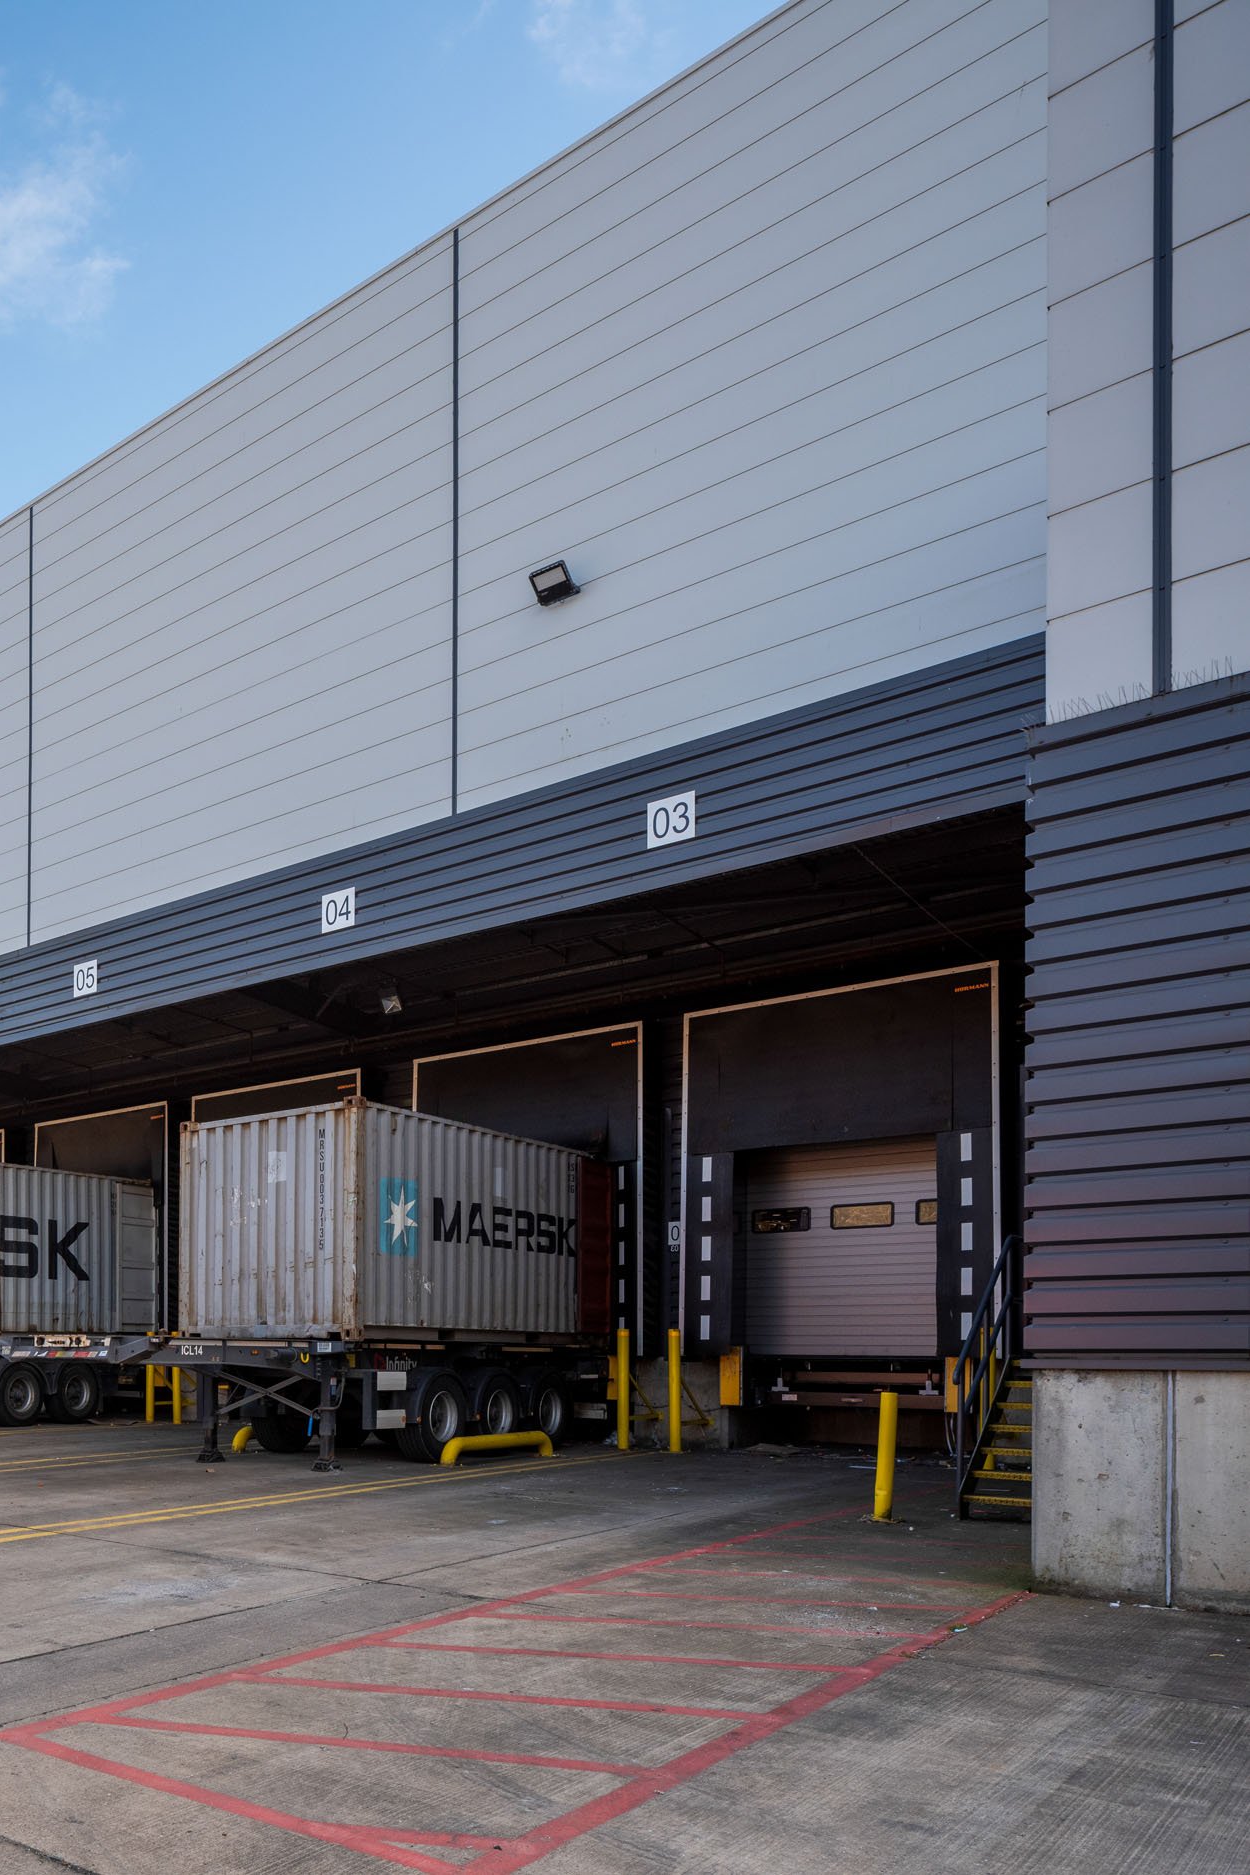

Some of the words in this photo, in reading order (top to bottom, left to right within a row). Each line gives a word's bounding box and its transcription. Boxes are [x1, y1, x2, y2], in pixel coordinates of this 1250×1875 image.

[653, 802, 690, 839] 03
[326, 895, 351, 925] 04
[76, 966, 95, 991] 05
[433, 1197, 578, 1258] MAERSK
[181, 1345, 203, 1356] ICL14
